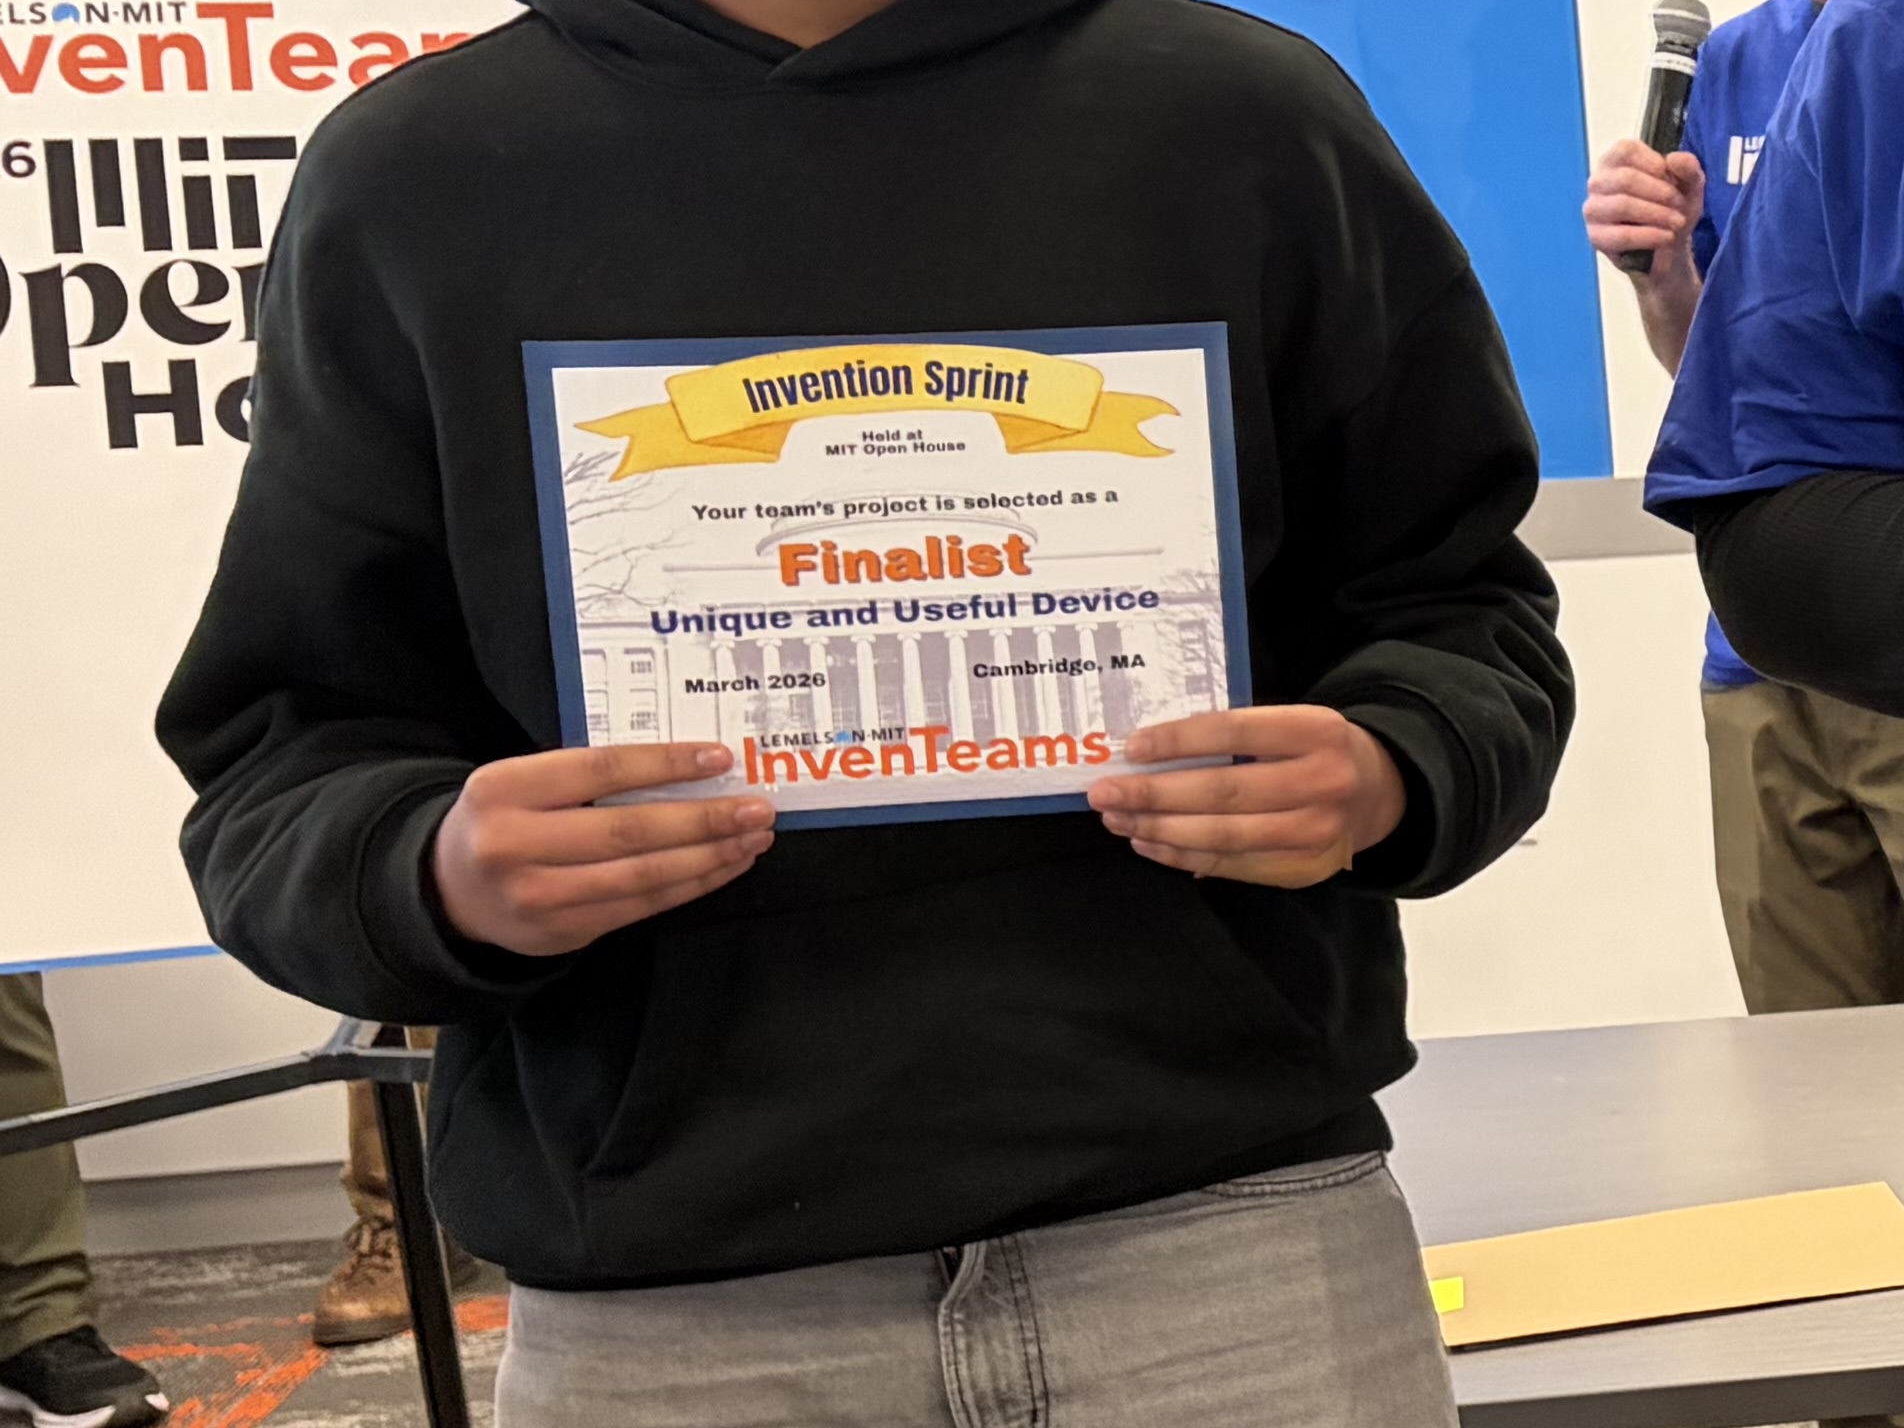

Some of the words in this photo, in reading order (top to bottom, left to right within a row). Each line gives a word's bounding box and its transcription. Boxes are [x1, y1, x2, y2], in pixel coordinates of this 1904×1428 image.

[0, 2, 477, 94] venTea
[742, 360, 913, 412] Invention
[924, 360, 1030, 405] Sprint
[826, 444, 856, 455] MIT
[864, 443, 908, 457] Open
[913, 440, 966, 453] House
[862, 430, 901, 442] Held
[906, 429, 923, 441] at
[692, 504, 746, 520] Your
[756, 501, 835, 518] team's
[844, 497, 928, 518] project
[936, 495, 956, 511] is
[964, 490, 1063, 509] selected
[1071, 491, 1098, 504] as
[1105, 490, 1118, 503] a
[778, 534, 1033, 587] Finalist
[650, 607, 793, 637] Unique
[806, 600, 879, 627] and
[893, 593, 1017, 623] Useful
[1032, 590, 1160, 616] Device
[685, 676, 759, 693] March
[768, 673, 826, 689] 2026
[973, 657, 1103, 679] Cambridge,
[1111, 654, 1146, 669] MA
[743, 725, 1112, 785] InvenTeams
